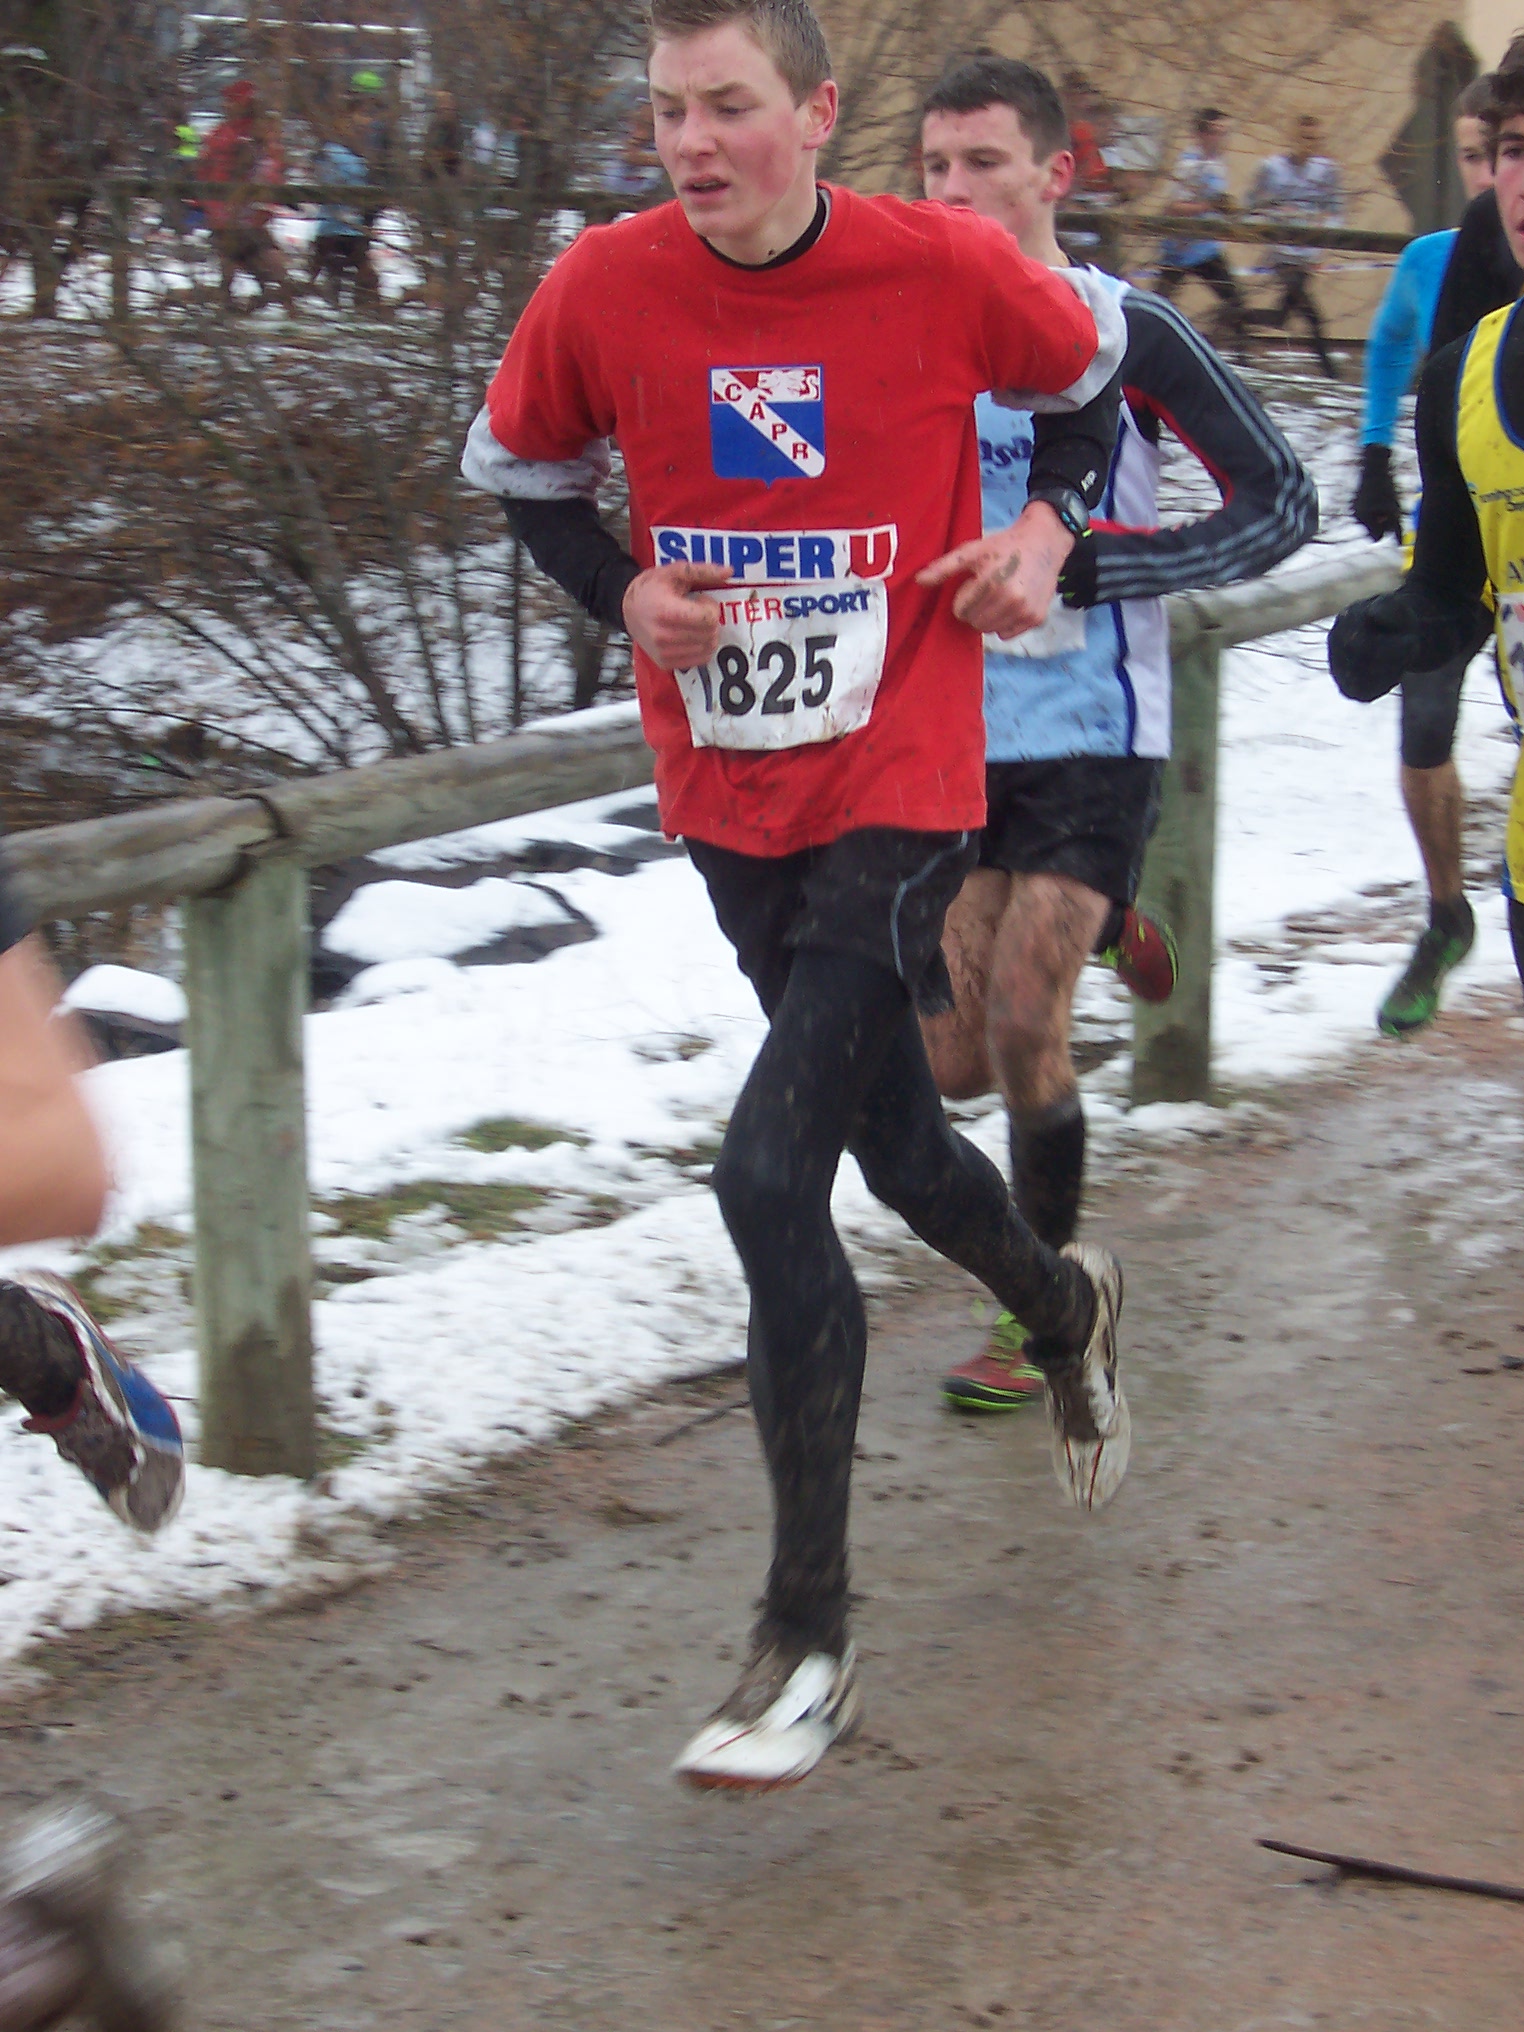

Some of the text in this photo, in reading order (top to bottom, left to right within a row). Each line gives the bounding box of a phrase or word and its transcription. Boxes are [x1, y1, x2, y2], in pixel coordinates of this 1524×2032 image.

[658, 531, 891, 579] SUPER U
[696, 634, 838, 716] 1825
